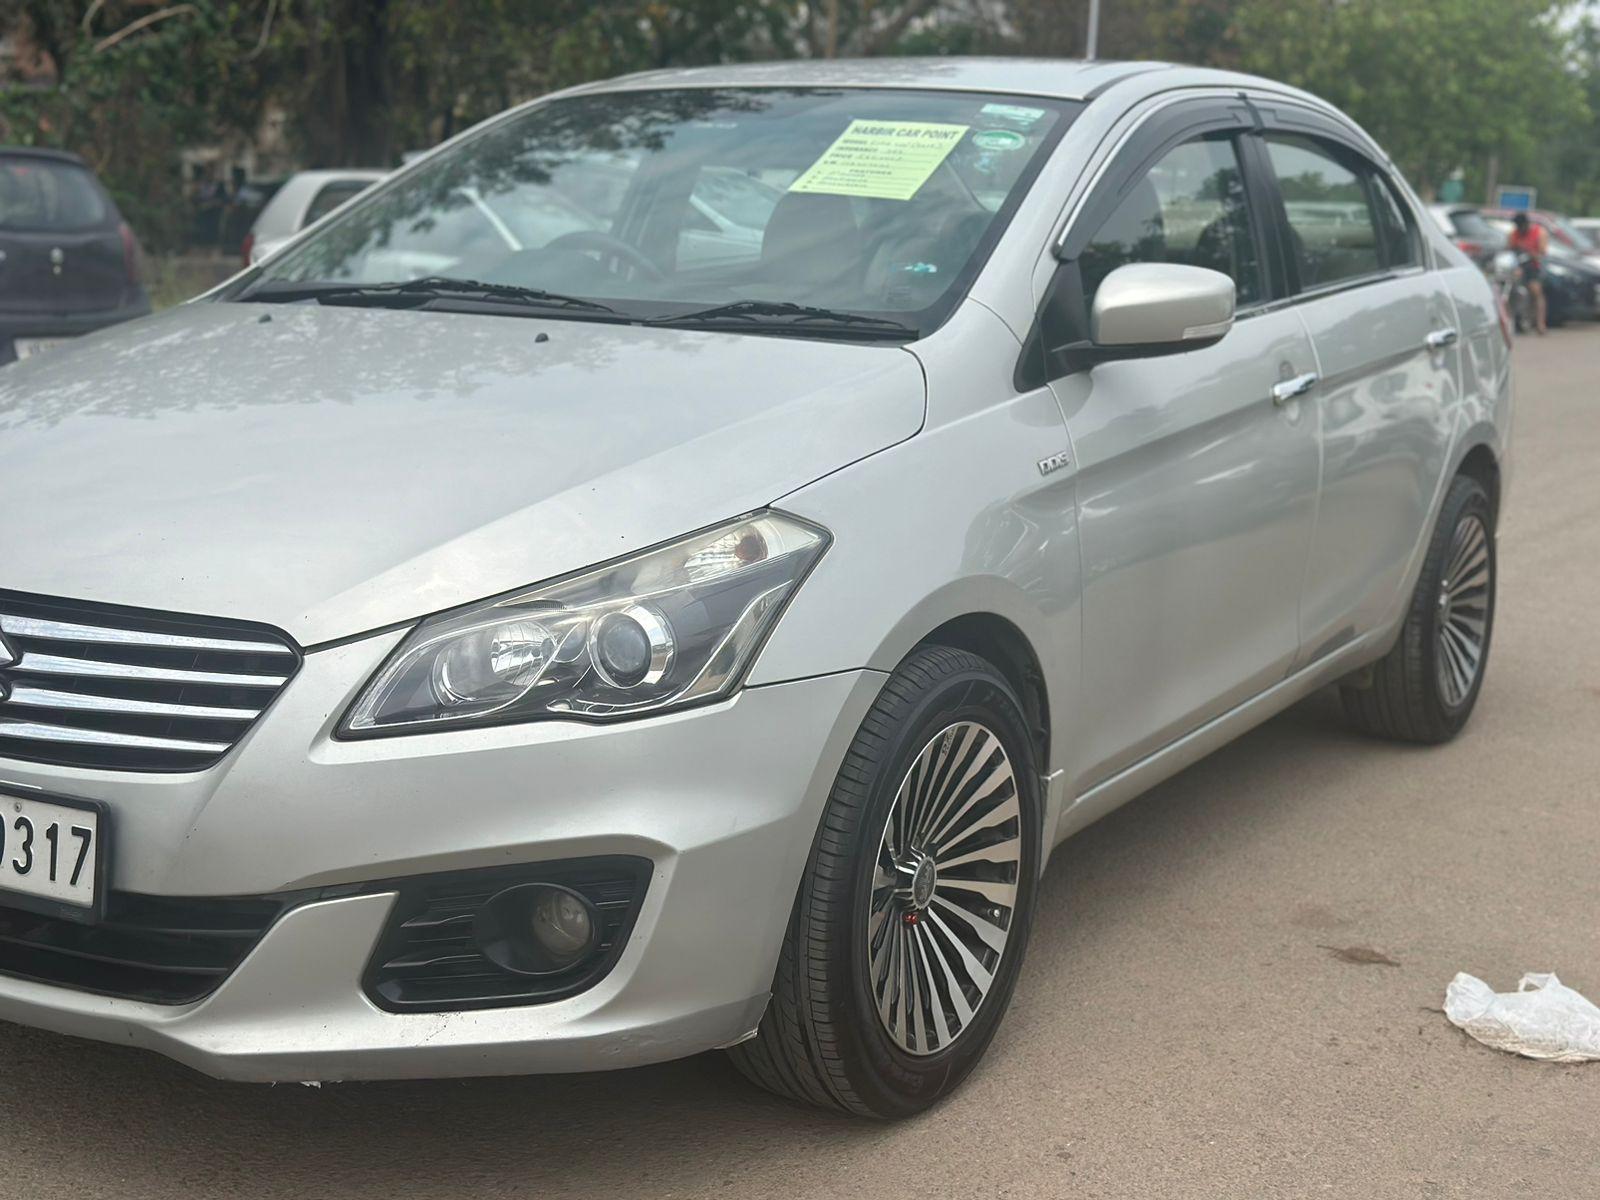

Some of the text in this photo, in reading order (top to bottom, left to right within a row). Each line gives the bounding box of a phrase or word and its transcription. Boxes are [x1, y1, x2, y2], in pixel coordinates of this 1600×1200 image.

[896, 128, 920, 137] CAR
[921, 130, 959, 140] POINT
[0, 813, 92, 886] 317
